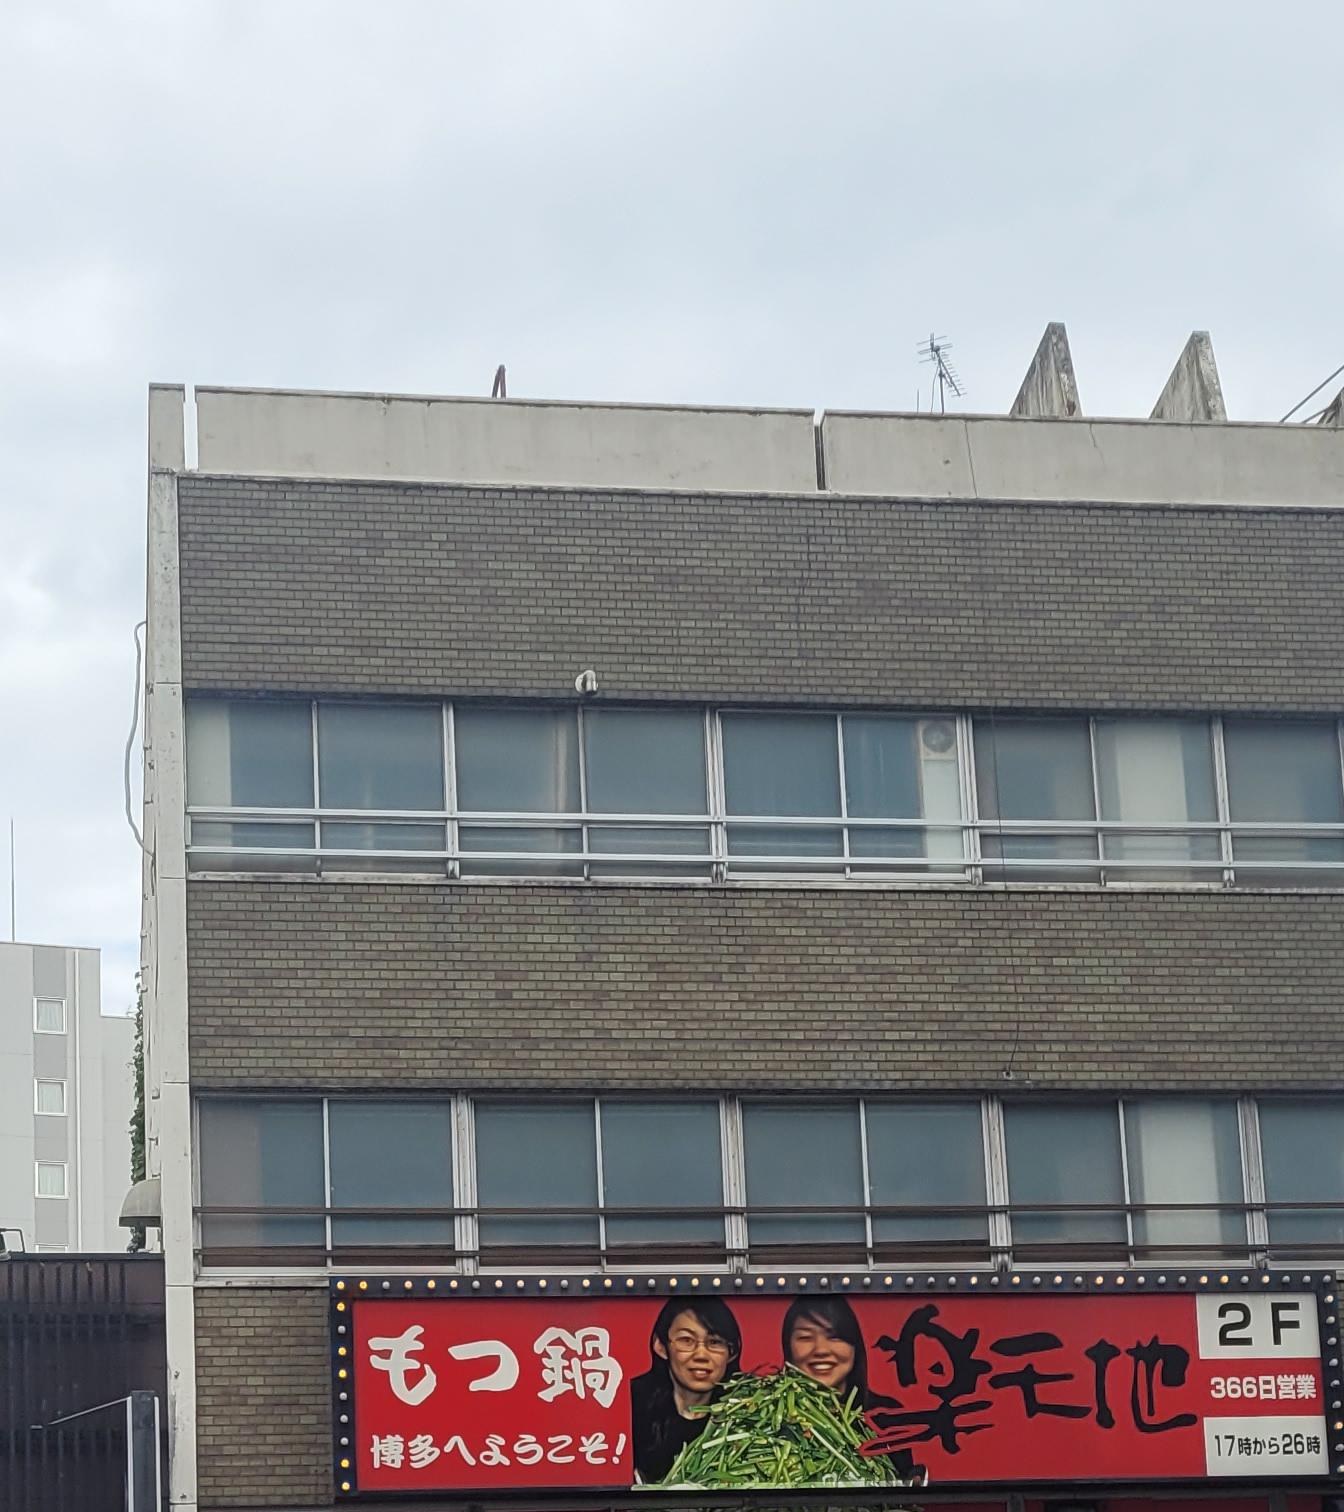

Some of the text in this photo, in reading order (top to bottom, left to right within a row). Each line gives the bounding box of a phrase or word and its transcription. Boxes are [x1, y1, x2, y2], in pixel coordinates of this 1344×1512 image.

[1217, 1302, 1304, 1347] 2F
[369, 1325, 623, 1408] もつ鍋
[860, 1303, 1197, 1456] 楽天地
[1210, 1373, 1317, 1401] 366日営業
[1214, 1433, 1321, 1458] 17時から26時
